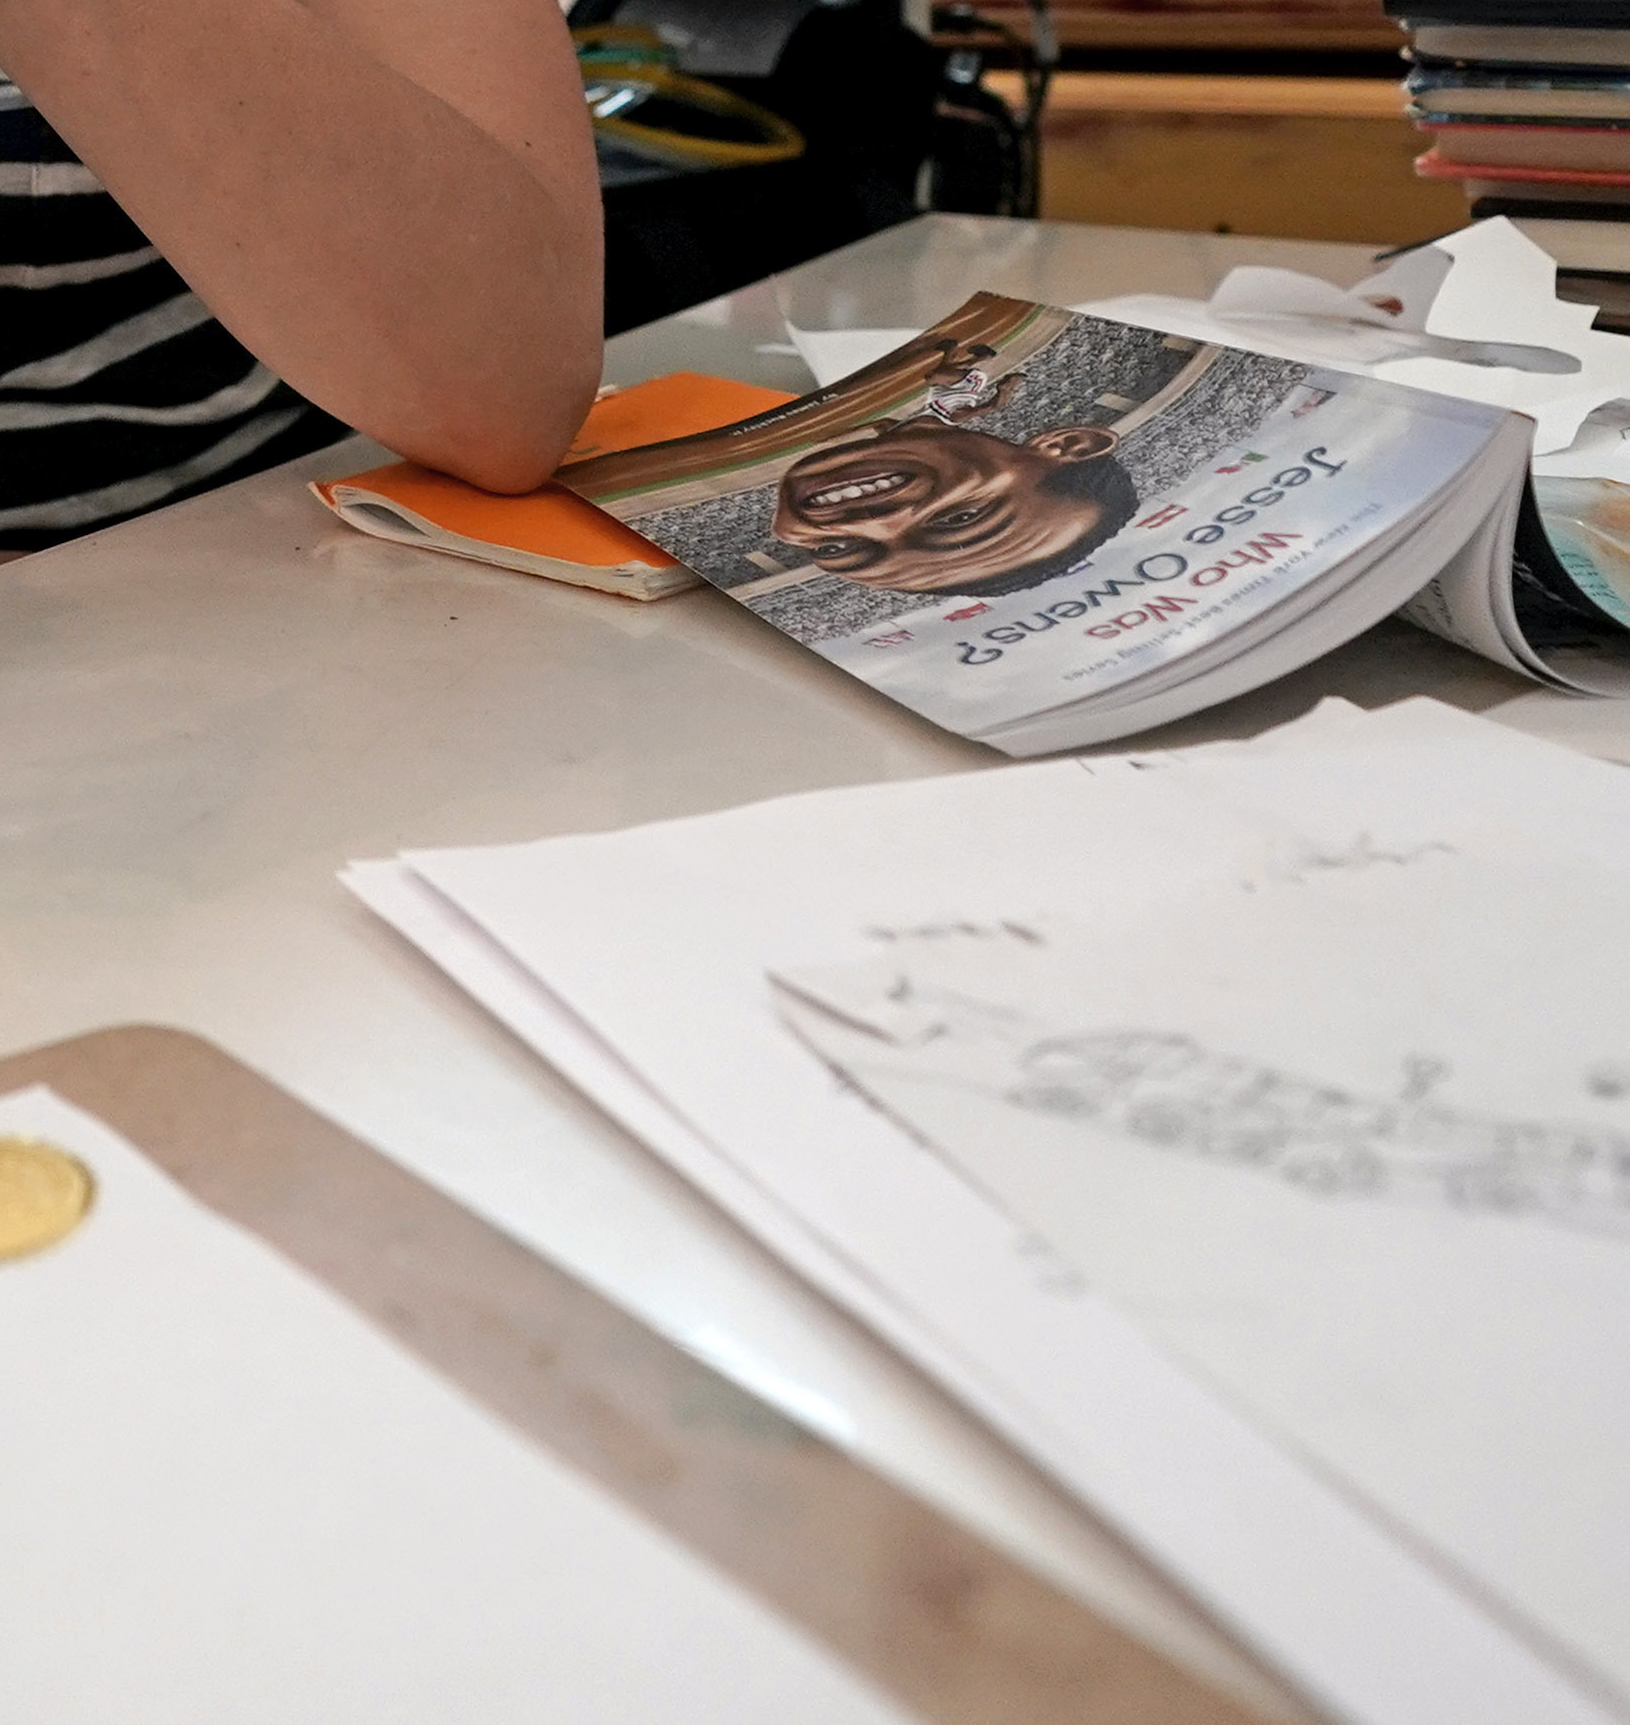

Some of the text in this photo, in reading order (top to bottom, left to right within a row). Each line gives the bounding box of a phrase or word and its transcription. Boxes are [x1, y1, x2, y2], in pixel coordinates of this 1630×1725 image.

[955, 446, 1348, 665] Jesse Owens?
[1085, 532, 1304, 639] Who Was
[1221, 576, 1272, 607] Times
